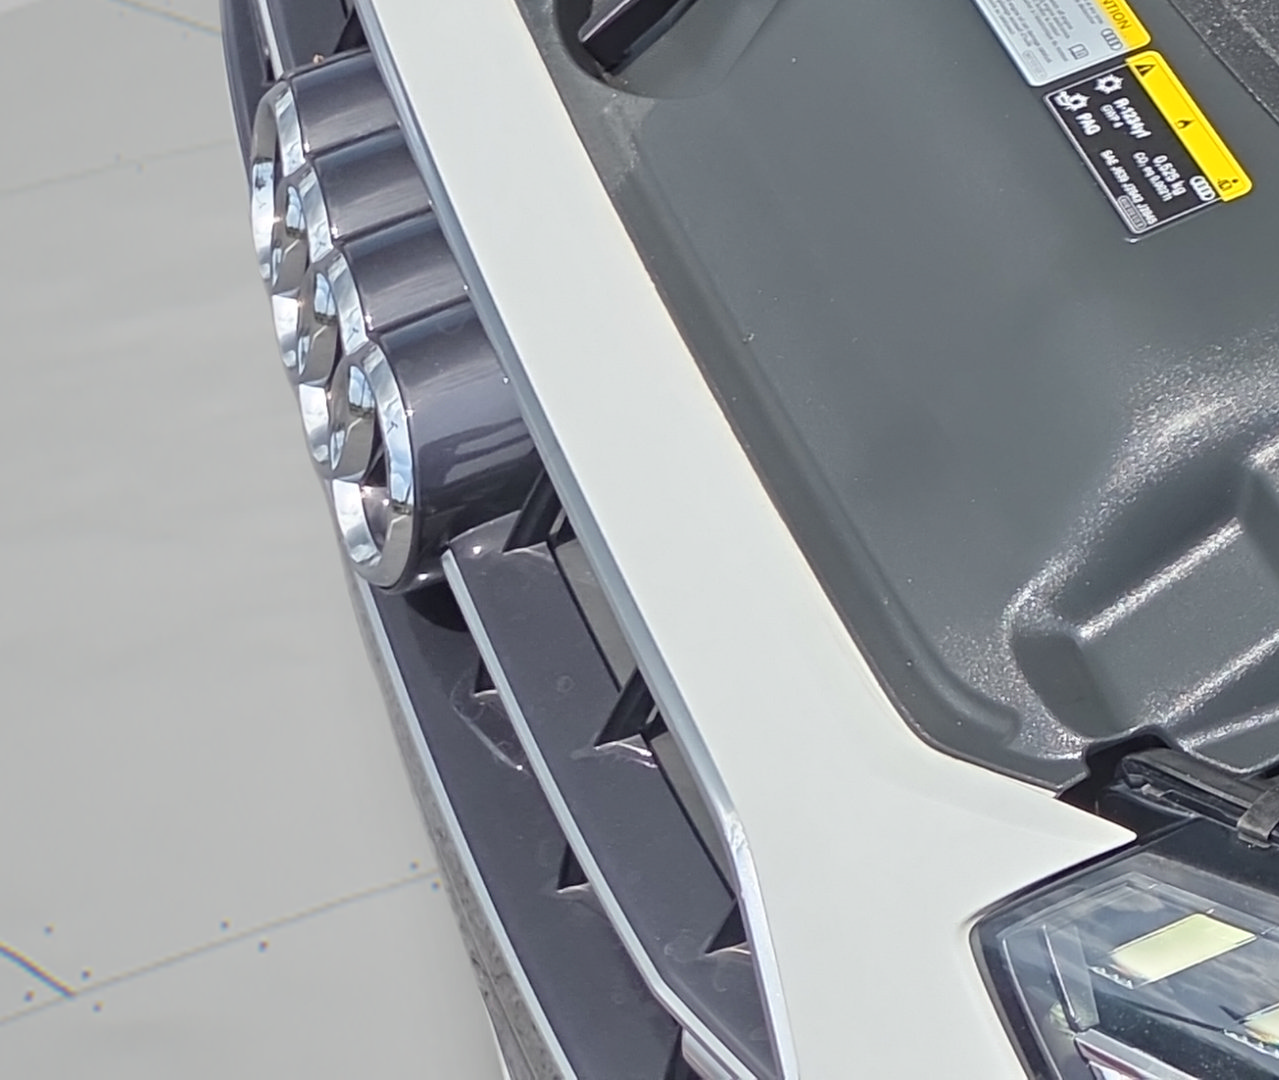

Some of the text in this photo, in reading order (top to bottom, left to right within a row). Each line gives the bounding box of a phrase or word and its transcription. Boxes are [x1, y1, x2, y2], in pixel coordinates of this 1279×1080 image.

[1073, 110, 1102, 136] PAG
[1098, 148, 1120, 166] SAE
[1167, 178, 1191, 196] kg
